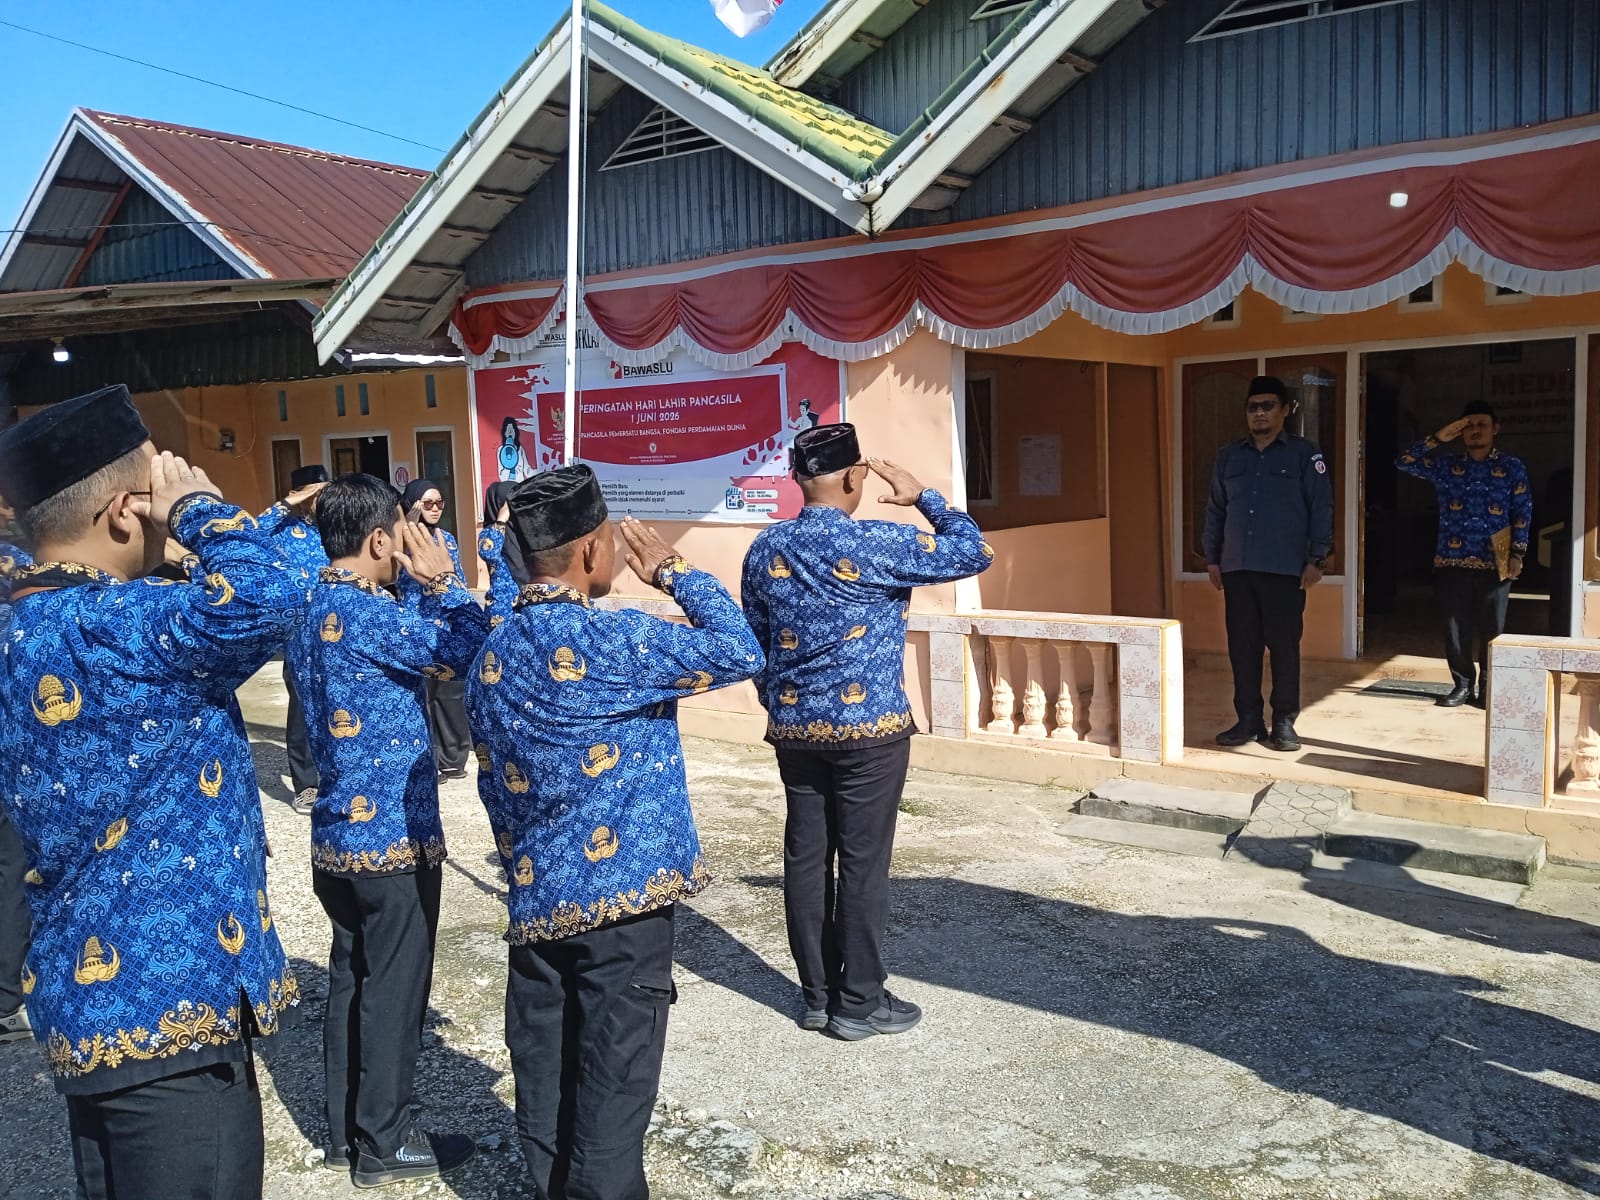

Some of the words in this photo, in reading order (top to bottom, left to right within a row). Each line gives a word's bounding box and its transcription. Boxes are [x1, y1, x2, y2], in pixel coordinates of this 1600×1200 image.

[623, 362, 673, 376] BAWASLU
[1491, 371, 1568, 395] MEDI
[580, 401, 633, 414] PERINGATAN
[635, 399, 657, 411] HARI
[659, 397, 687, 409] LAHIR
[689, 393, 742, 406] PANCASILA
[636, 412, 657, 424] JUNI
[659, 411, 680, 422] 2026
[580, 431, 609, 439] PANCASILA
[609, 429, 639, 437] PEMERSATU
[662, 427, 687, 435] FONDASI
[687, 424, 726, 433] PERDAMAIAN
[727, 423, 746, 431] DUNIA
